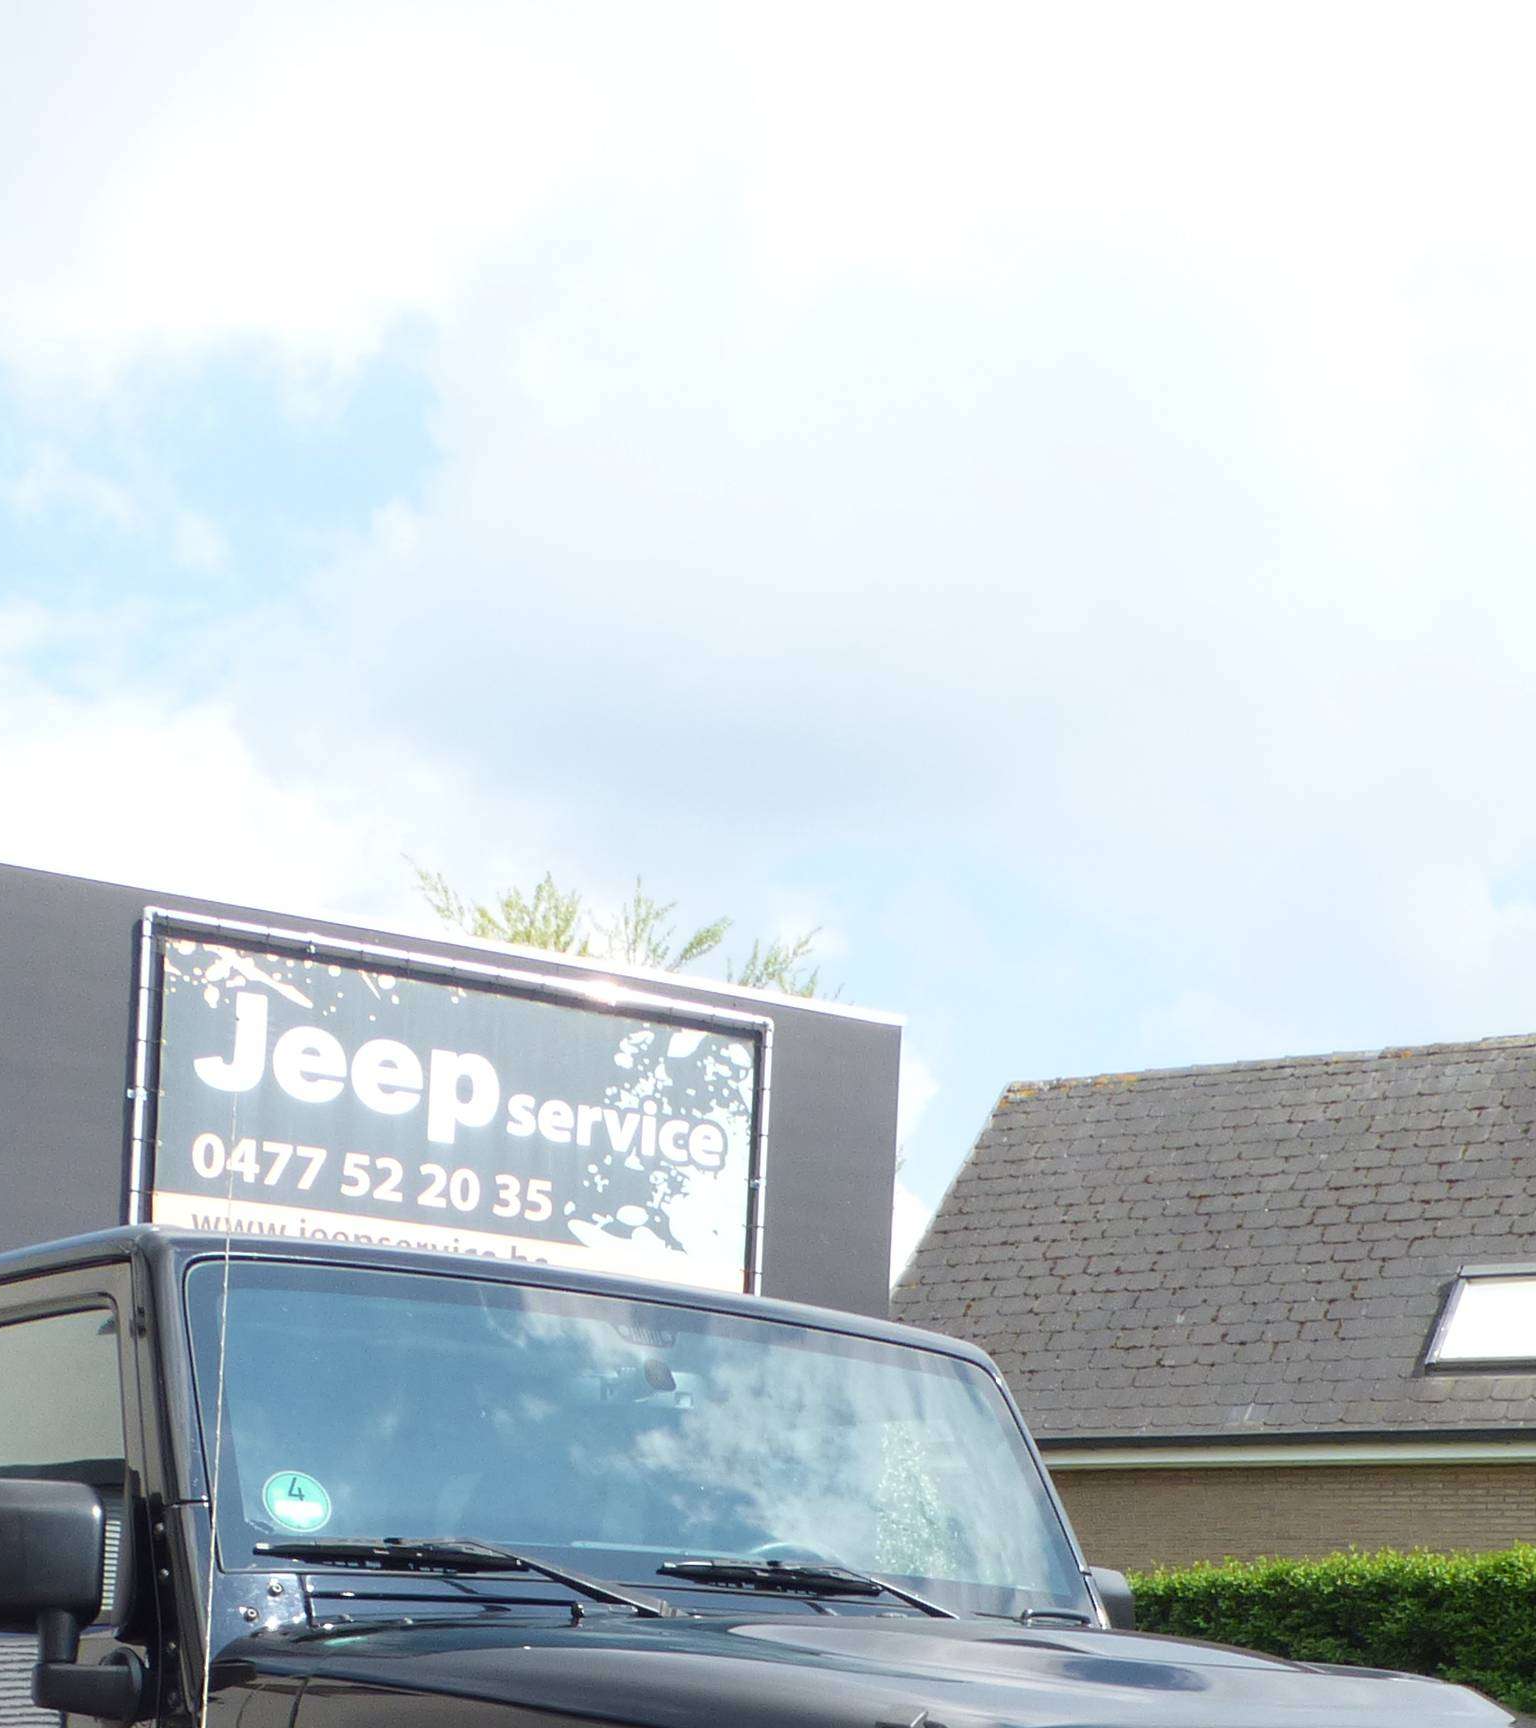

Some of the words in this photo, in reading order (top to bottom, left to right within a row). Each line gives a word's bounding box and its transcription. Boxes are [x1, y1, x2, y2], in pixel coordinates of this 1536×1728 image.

[193, 991, 500, 1144] Jeep
[506, 1094, 725, 1167] service
[192, 1133, 327, 1190] 0477
[340, 1152, 404, 1203] 52
[417, 1163, 481, 1212] 20
[492, 1174, 553, 1222] 35
[287, 1477, 305, 1501] 4
